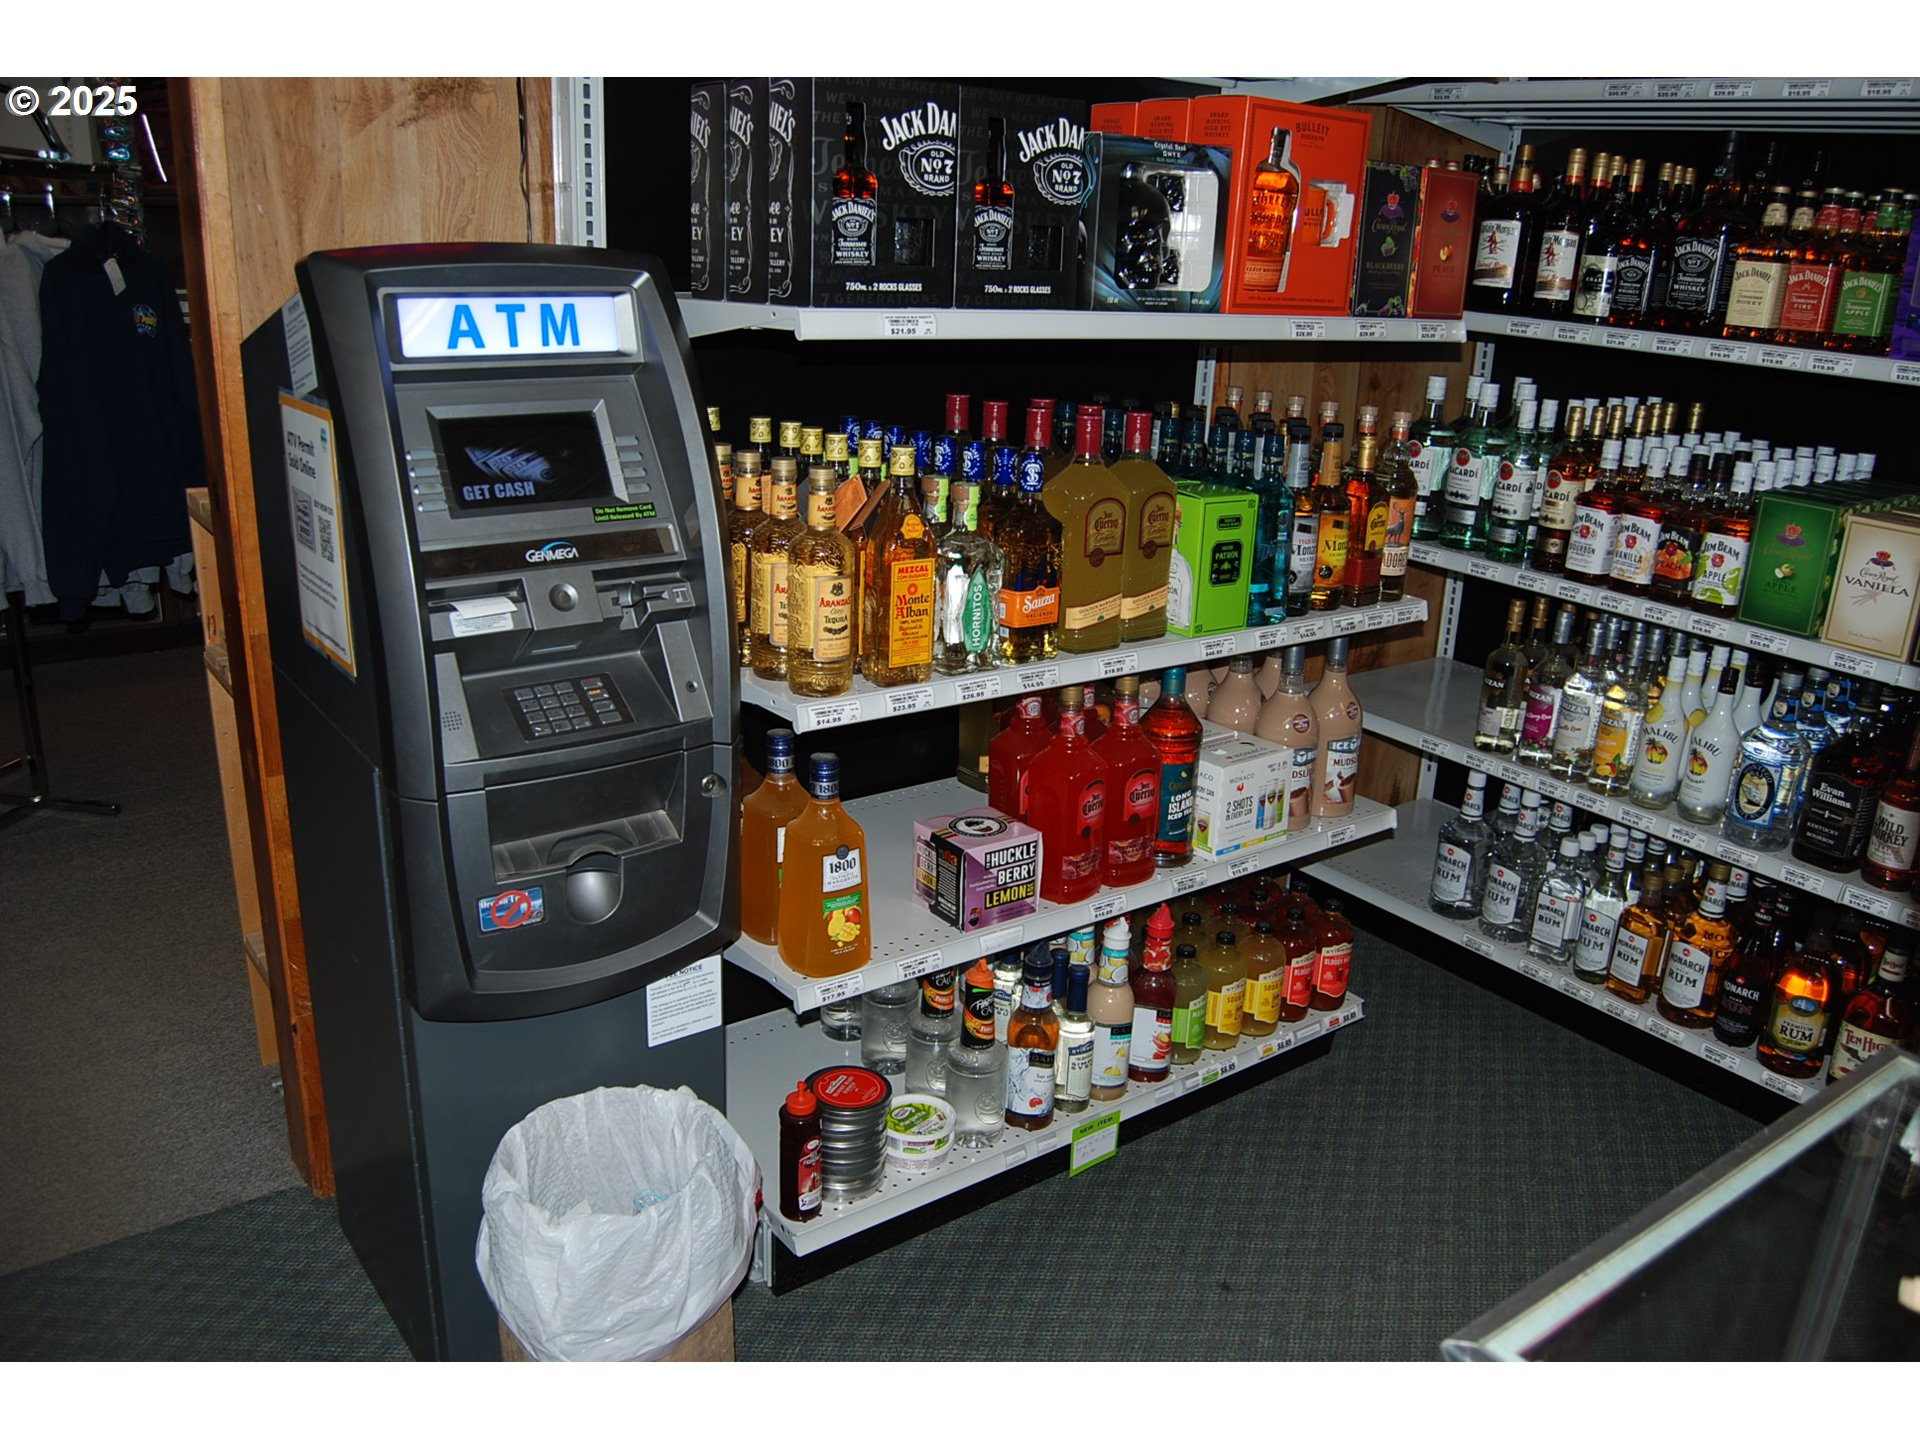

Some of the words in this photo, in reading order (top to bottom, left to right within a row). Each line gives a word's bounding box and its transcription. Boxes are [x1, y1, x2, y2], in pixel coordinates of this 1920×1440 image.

[880, 109, 926, 151] JACK
[1296, 122, 1330, 137] BULLEIT
[1017, 123, 1058, 163] JACK
[930, 150, 945, 158] OLD
[943, 159, 955, 174] 7
[1061, 162, 1073, 170] OLD
[924, 173, 950, 183] BRAND
[1072, 170, 1082, 185] 7
[1054, 184, 1078, 193] BRAND
[832, 203, 848, 221] JACK
[847, 201, 876, 222] DANIEL'S
[974, 210, 991, 228] JACK
[1674, 241, 1692, 258] JACK
[1691, 240, 1719, 260] DANIEL'S
[1734, 266, 1750, 282] JACK
[1787, 270, 1804, 285] JACK
[879, 282, 897, 292] ROCKS
[898, 282, 922, 292] GLASSES
[1013, 285, 1029, 293] ROCKS
[1030, 285, 1051, 294] GLASSES
[1673, 284, 1706, 293] WHISKEY
[1843, 277, 1860, 291] JACK
[1859, 276, 1883, 293] DANIEL'S
[1793, 302, 1812, 310] FIRE
[447, 303, 580, 349] ATM
[890, 327, 917, 336] $21.95
[462, 484, 491, 501] GET
[494, 481, 536, 500] CASH
[609, 512, 634, 521] Released
[634, 512, 643, 520] By
[615, 505, 640, 513] Remove
[1094, 515, 1119, 532] Cuervo
[1584, 512, 1604, 531] BEAM
[1630, 522, 1652, 541] BEAM
[1659, 531, 1671, 542] JIM
[1670, 530, 1689, 546] BEAM
[1569, 542, 1596, 555] BOURBON
[1702, 541, 1717, 554] JIM
[1717, 540, 1740, 560] BEAM
[1615, 550, 1643, 564] VANILLA
[1656, 559, 1682, 570] PEACH
[897, 564, 929, 575] MEZCAL
[1702, 569, 1727, 583] APPLE
[1845, 575, 1909, 597] VANILLA
[895, 594, 930, 607] Monte
[1022, 593, 1055, 614] Sauza
[824, 615, 848, 624] TEQUILA
[895, 605, 929, 620] Alban
[972, 584, 982, 647] HORNITOS
[962, 691, 985, 700] $26.95
[893, 703, 917, 712] $23.95
[817, 716, 842, 726] $14.95
[1332, 741, 1350, 750] ICE
[1229, 773, 1256, 784] MONACO
[1129, 788, 1156, 804] Cuervo
[1170, 790, 1192, 802] LONG
[1820, 781, 1845, 798] Evan
[1226, 802, 1231, 813] 2
[1232, 795, 1254, 812] SHOTS
[1812, 787, 1852, 810] Williams
[1167, 811, 1183, 820] ICED
[1225, 813, 1231, 821] IN
[1231, 810, 1244, 821] EVERY
[1244, 808, 1253, 816] CAN
[1806, 821, 1839, 836] KENTUCKY
[1879, 816, 1905, 834] WILD
[1805, 830, 1835, 845] BOURBON
[990, 842, 1037, 867] HUCKLE
[829, 857, 856, 874] 1800
[998, 861, 1036, 885] BERRY
[1436, 866, 1461, 883] RUM
[985, 884, 1027, 908] LEMON
[1537, 903, 1566, 918] MONARCH
[1538, 914, 1561, 928] RUM
[1618, 938, 1644, 956] MONARCH
[1616, 950, 1639, 966] RUM
[1668, 968, 1698, 988] RUM
[1263, 983, 1279, 992] SOUR
[822, 990, 846, 1002] $17.95
[1783, 1019, 1815, 1032] PREMIUM
[1779, 1024, 1813, 1043] RUM
[1845, 1028, 1863, 1045] TEN
[1079, 1124, 1094, 1135] NEW
[1097, 1116, 1114, 1128] ITEM
